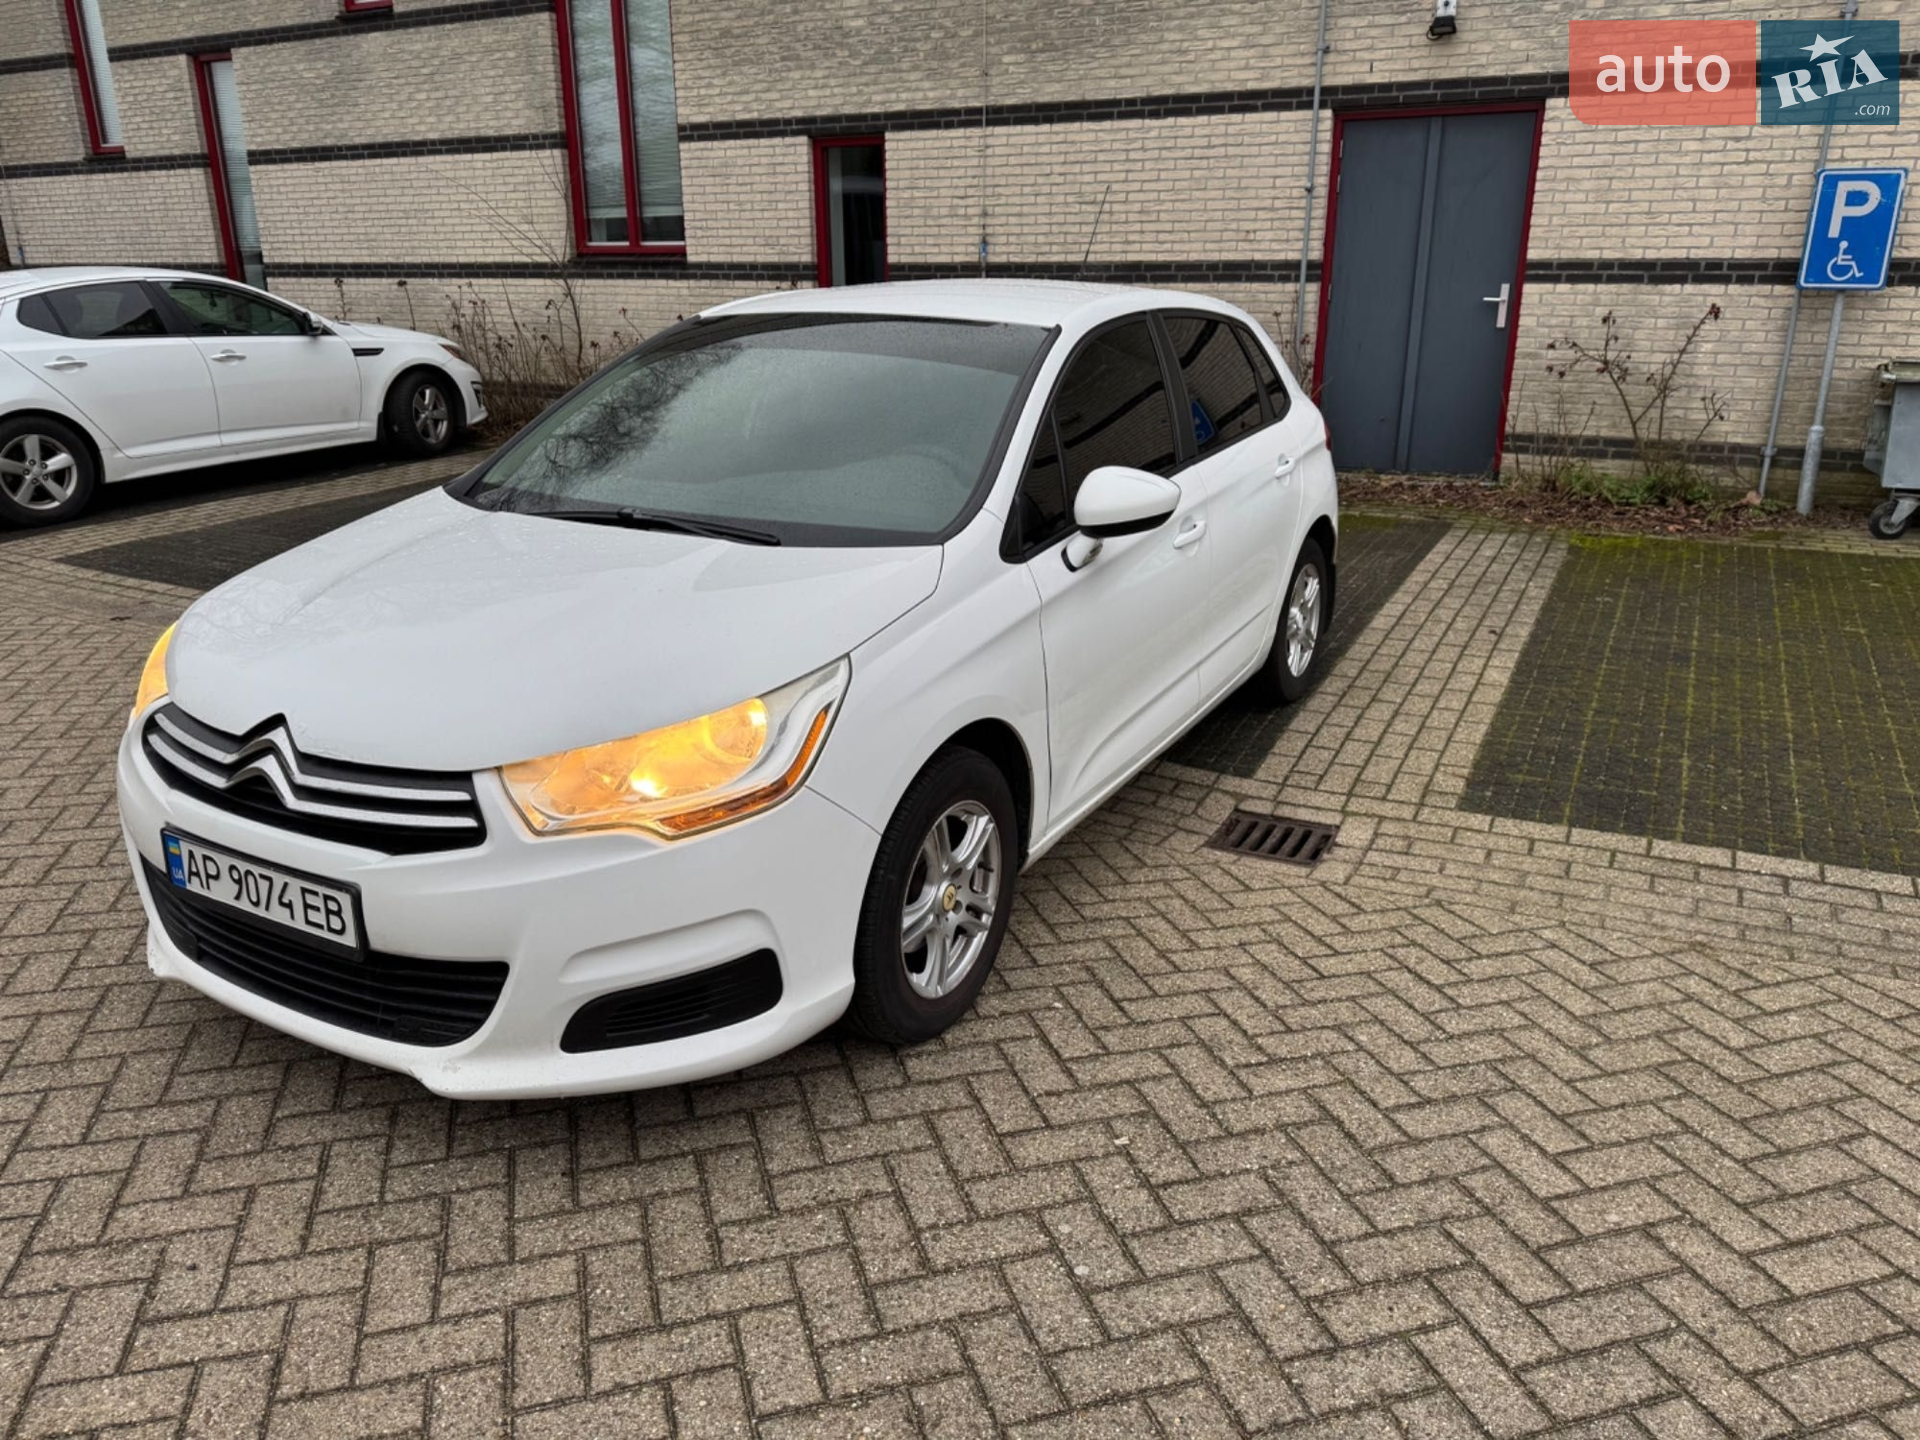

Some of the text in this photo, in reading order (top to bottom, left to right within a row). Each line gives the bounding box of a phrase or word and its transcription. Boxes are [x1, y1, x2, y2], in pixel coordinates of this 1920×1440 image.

[1828, 180, 1881, 238] P
[172, 867, 184, 880] UA
[187, 849, 346, 936] AP 9074 EB
